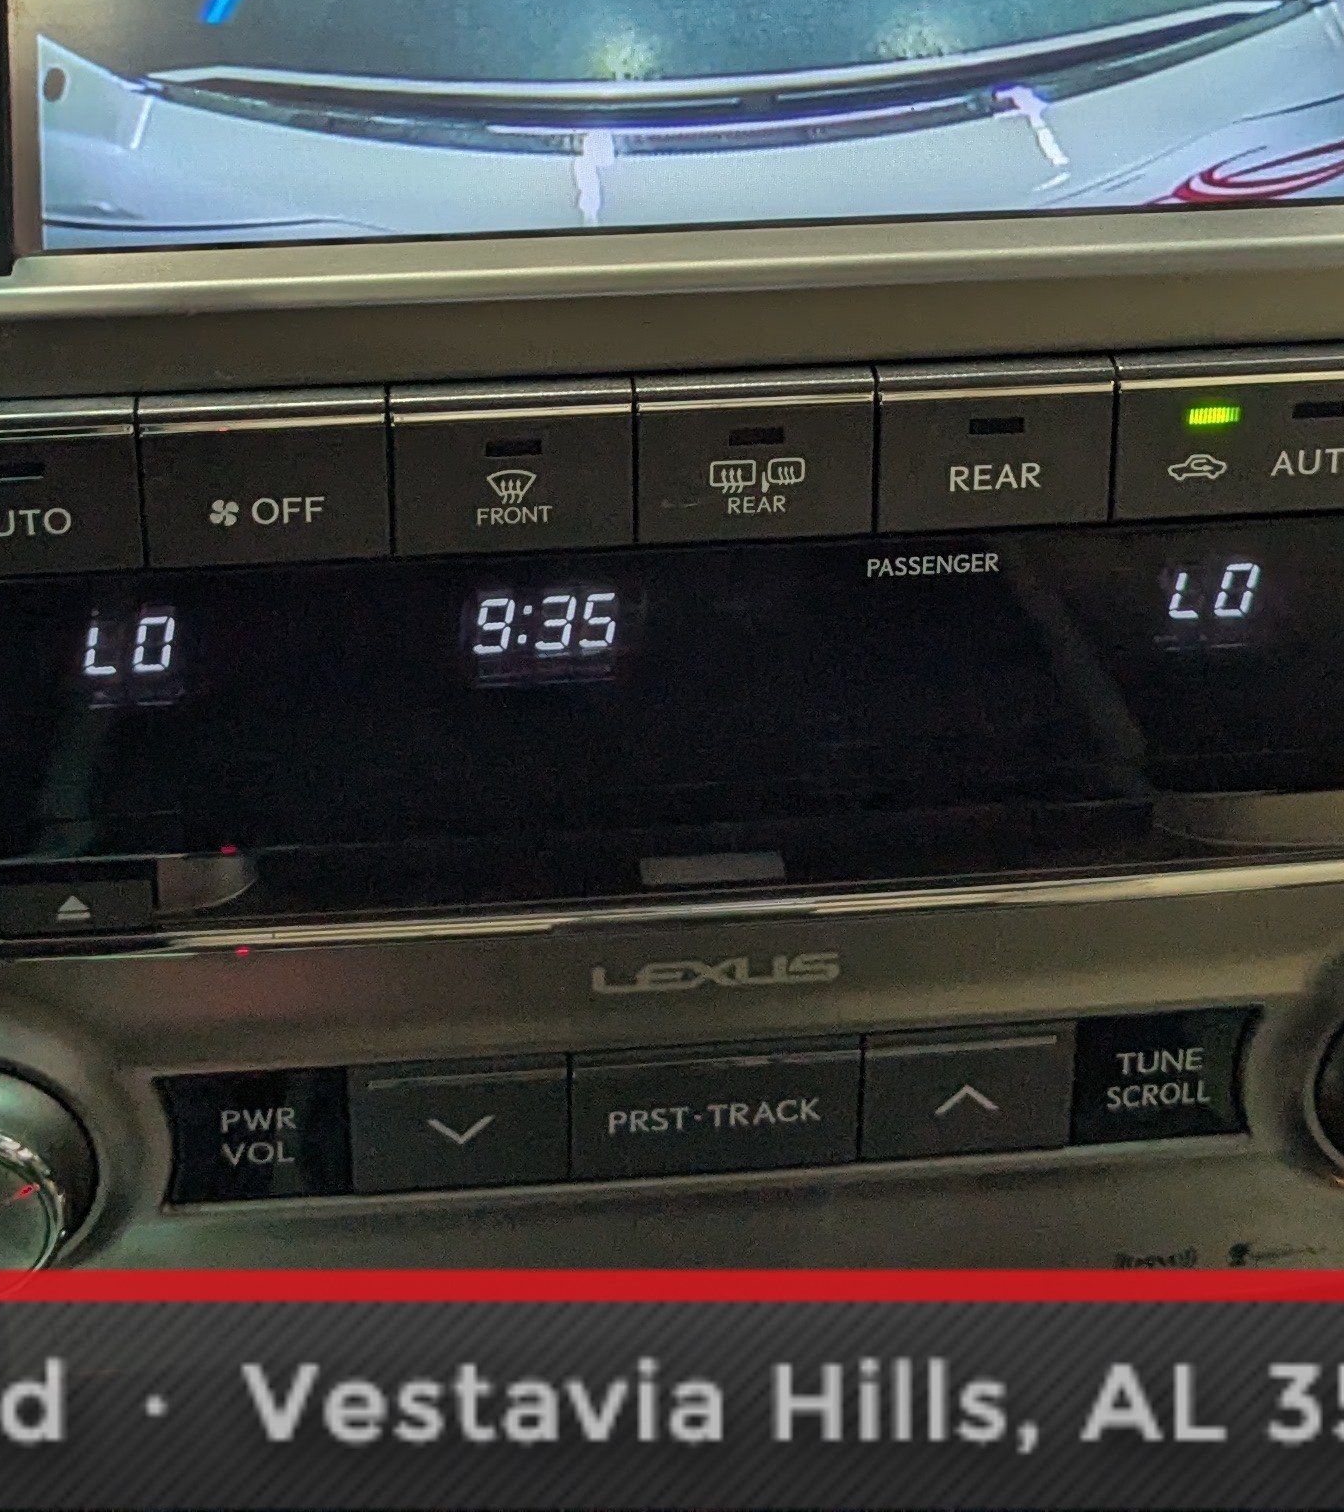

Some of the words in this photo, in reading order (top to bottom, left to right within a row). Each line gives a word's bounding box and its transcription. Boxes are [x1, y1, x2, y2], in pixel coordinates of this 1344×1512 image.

[948, 462, 1042, 493] REAR
[251, 496, 326, 525] OFF
[475, 503, 553, 526] FRONT
[726, 494, 787, 515] REAR
[866, 552, 1000, 578] PASSENGER
[473, 592, 618, 654] 9:35
[591, 952, 842, 991] LEXUS
[1116, 1047, 1204, 1074] TUNE
[1106, 1083, 1211, 1110] SCROLL
[220, 1106, 298, 1135] PWR
[221, 1140, 296, 1167] VOL
